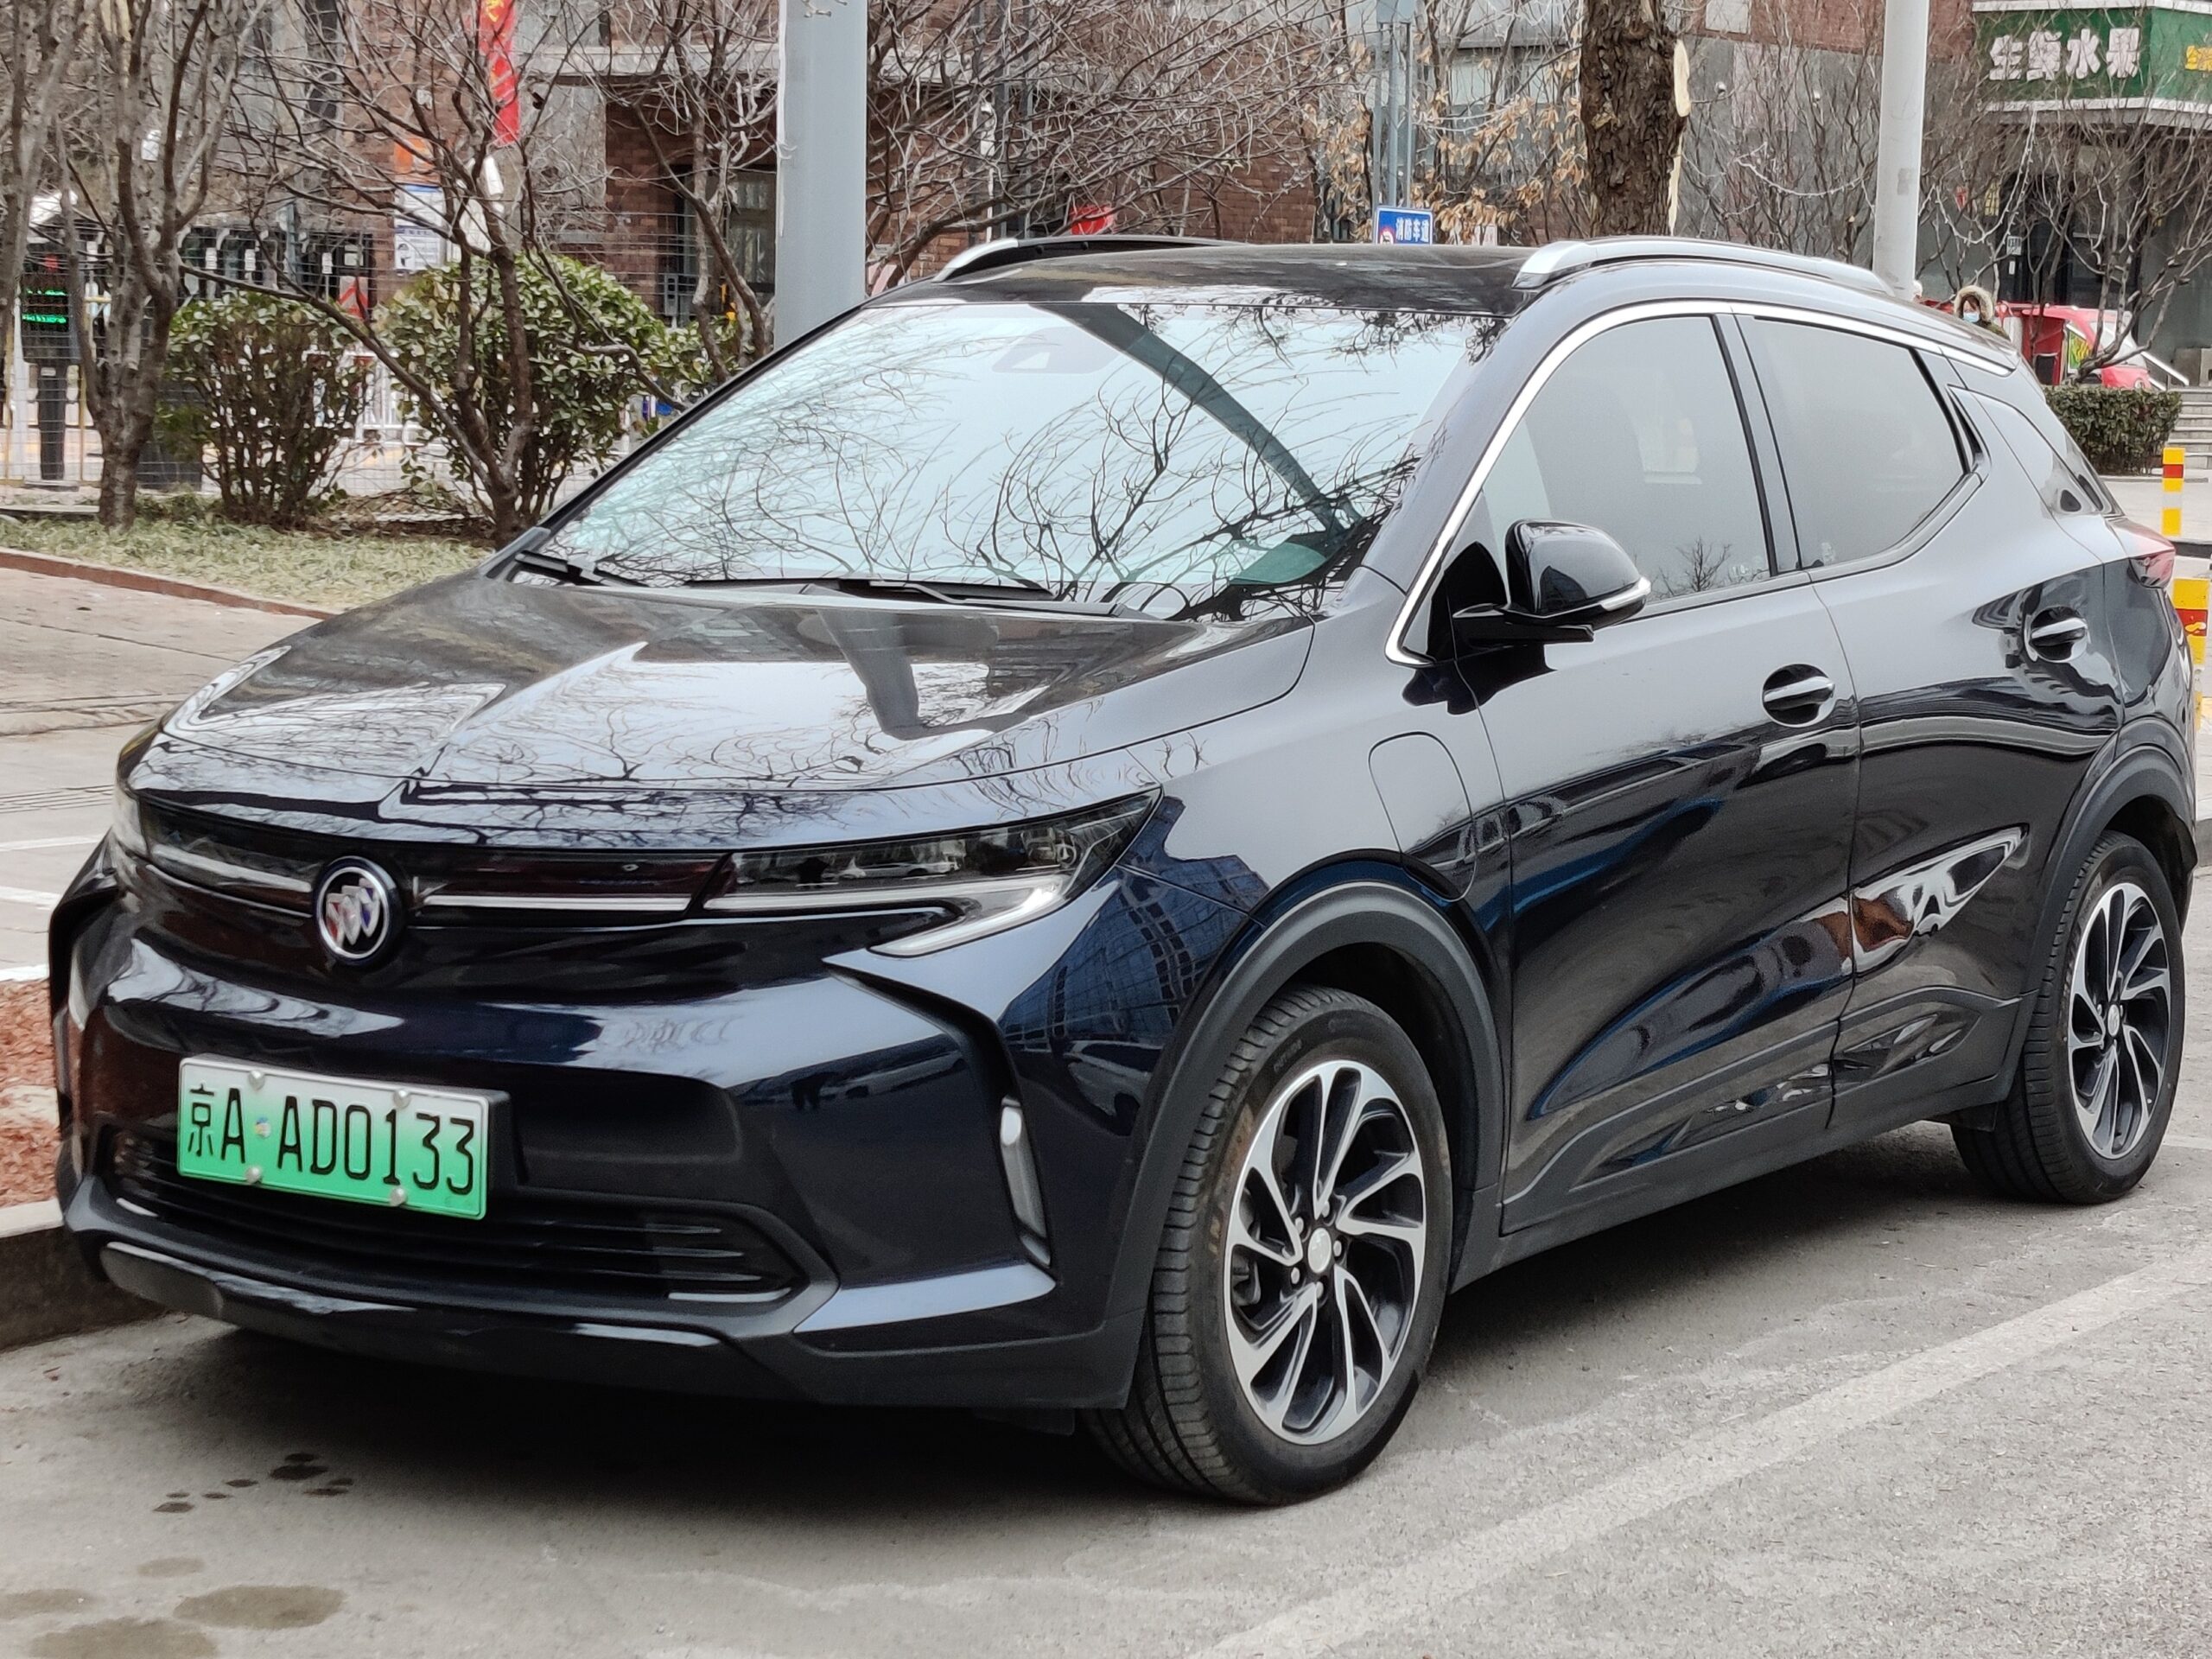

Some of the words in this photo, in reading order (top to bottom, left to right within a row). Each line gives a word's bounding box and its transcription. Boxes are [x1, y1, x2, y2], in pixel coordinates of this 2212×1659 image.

[1989, 28, 2140, 81] 生鲜水果
[188, 1084, 246, 1164] 京A
[277, 1096, 474, 1196] AD0133
